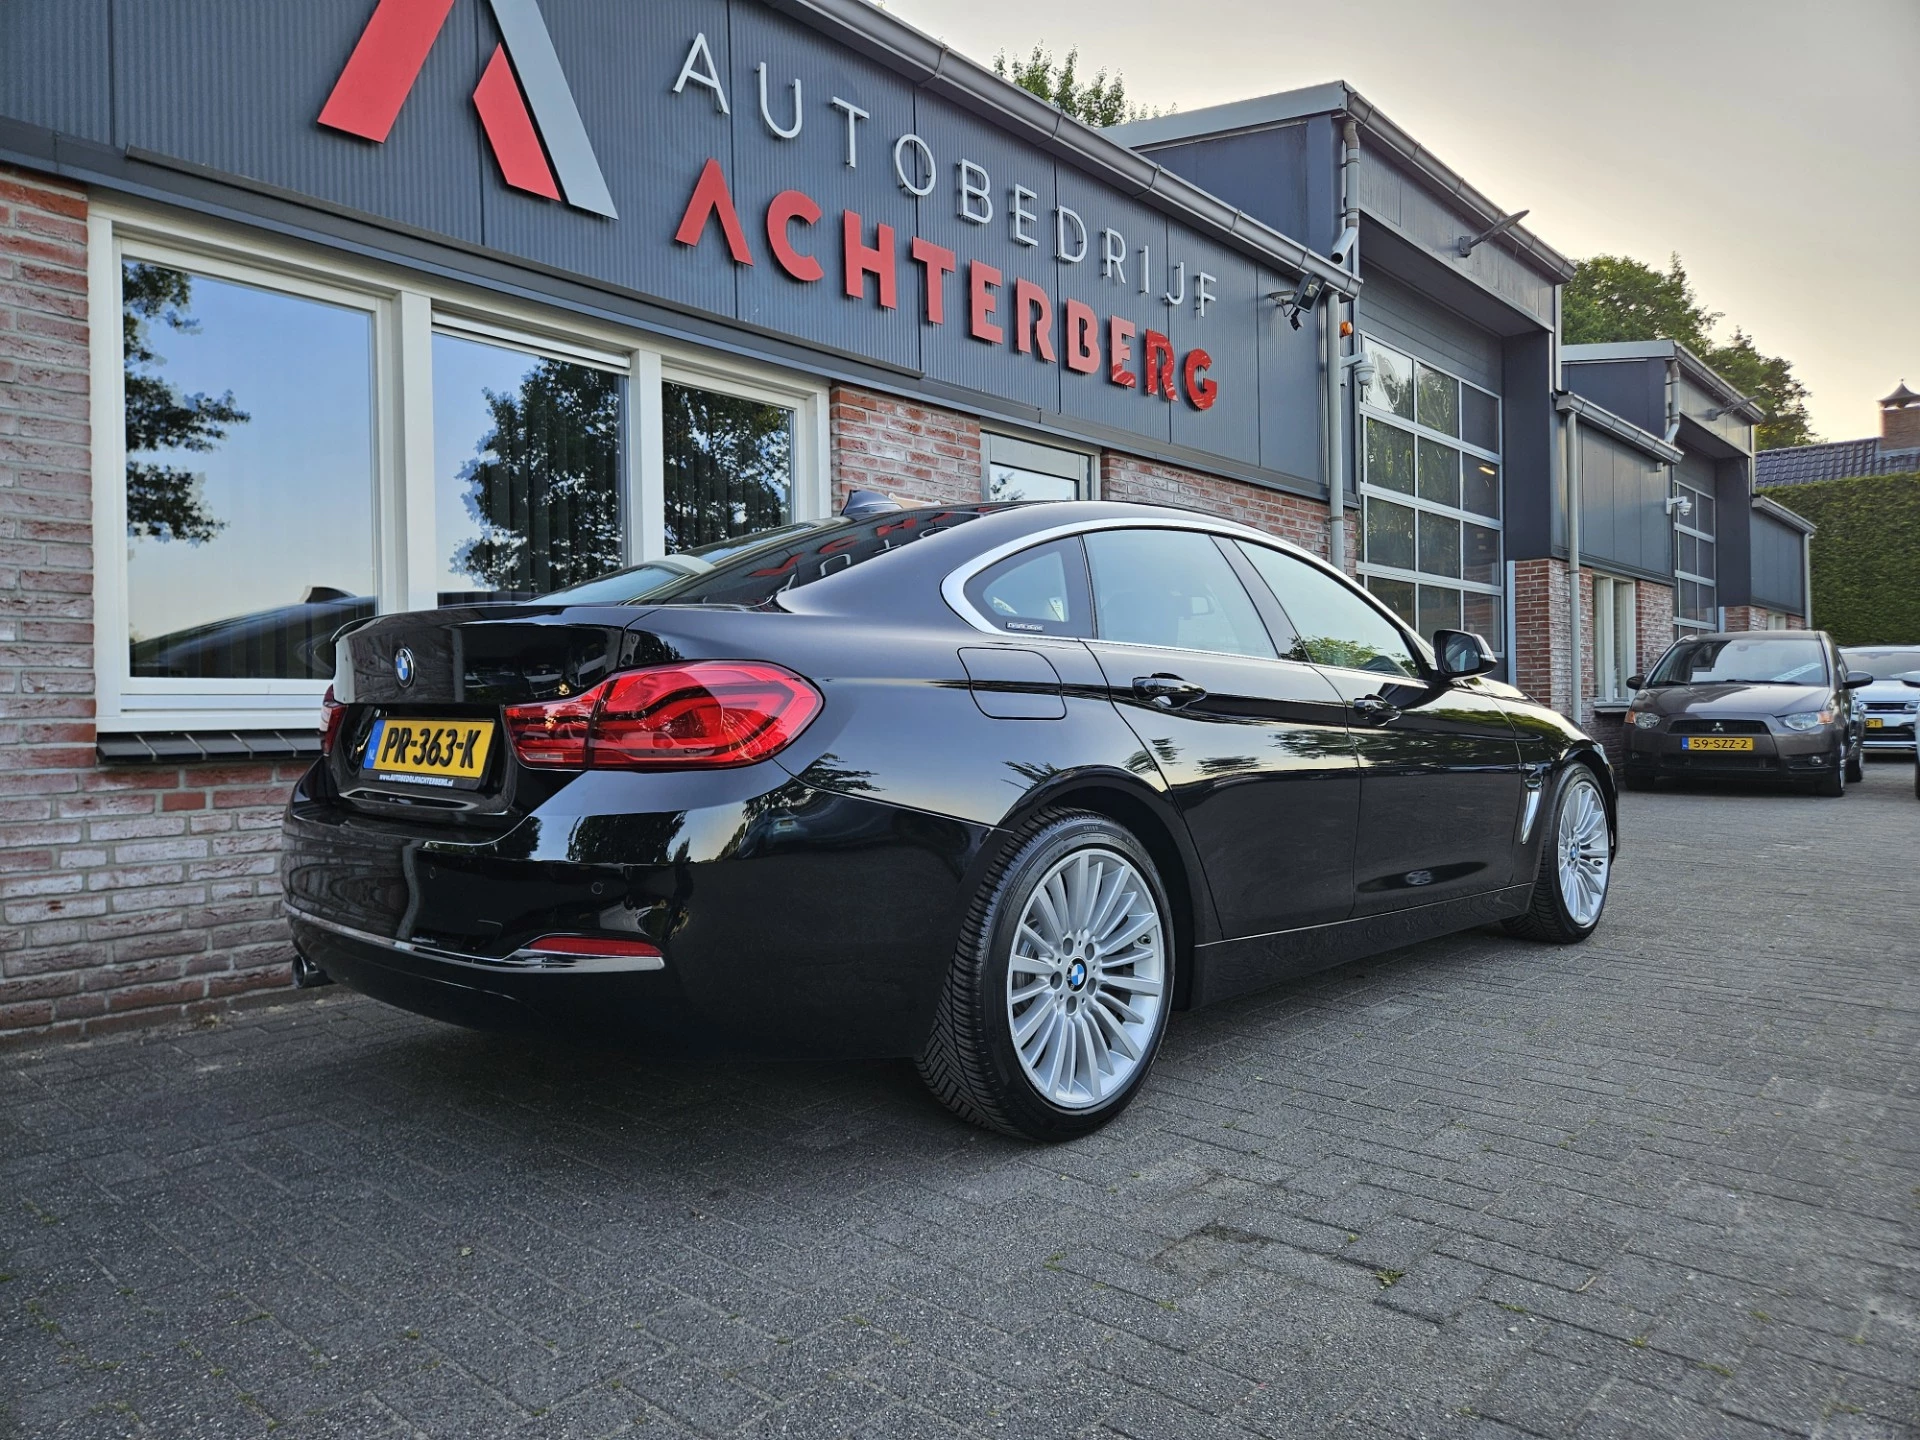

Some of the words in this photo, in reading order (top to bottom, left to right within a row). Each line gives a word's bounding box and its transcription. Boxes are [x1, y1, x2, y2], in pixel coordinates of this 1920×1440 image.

[672, 32, 1217, 318] AUTOBEDRIJF
[675, 158, 1218, 411] ACHTERBERG
[381, 727, 482, 769] PR-363-K
[1693, 739, 1748, 749] 59-SZZ-2
